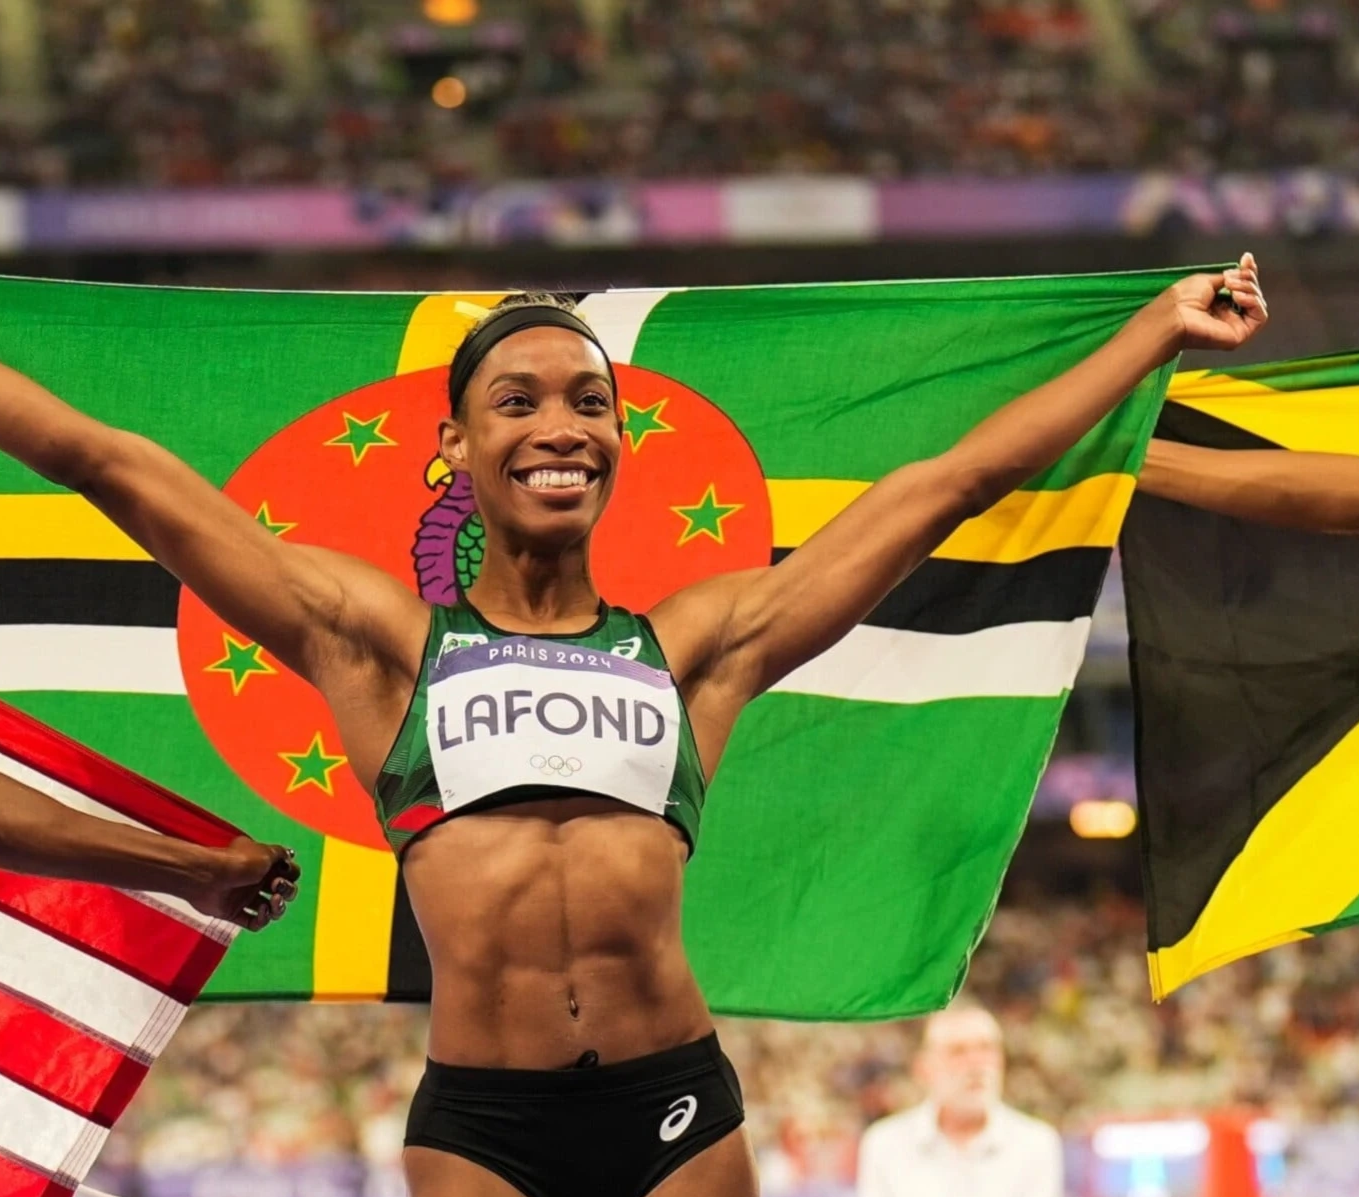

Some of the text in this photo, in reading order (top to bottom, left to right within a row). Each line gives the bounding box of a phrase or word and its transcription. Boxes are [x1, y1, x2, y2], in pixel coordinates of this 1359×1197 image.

[489, 644, 612, 669] PARIS 2024
[437, 690, 666, 751] LAFOND
